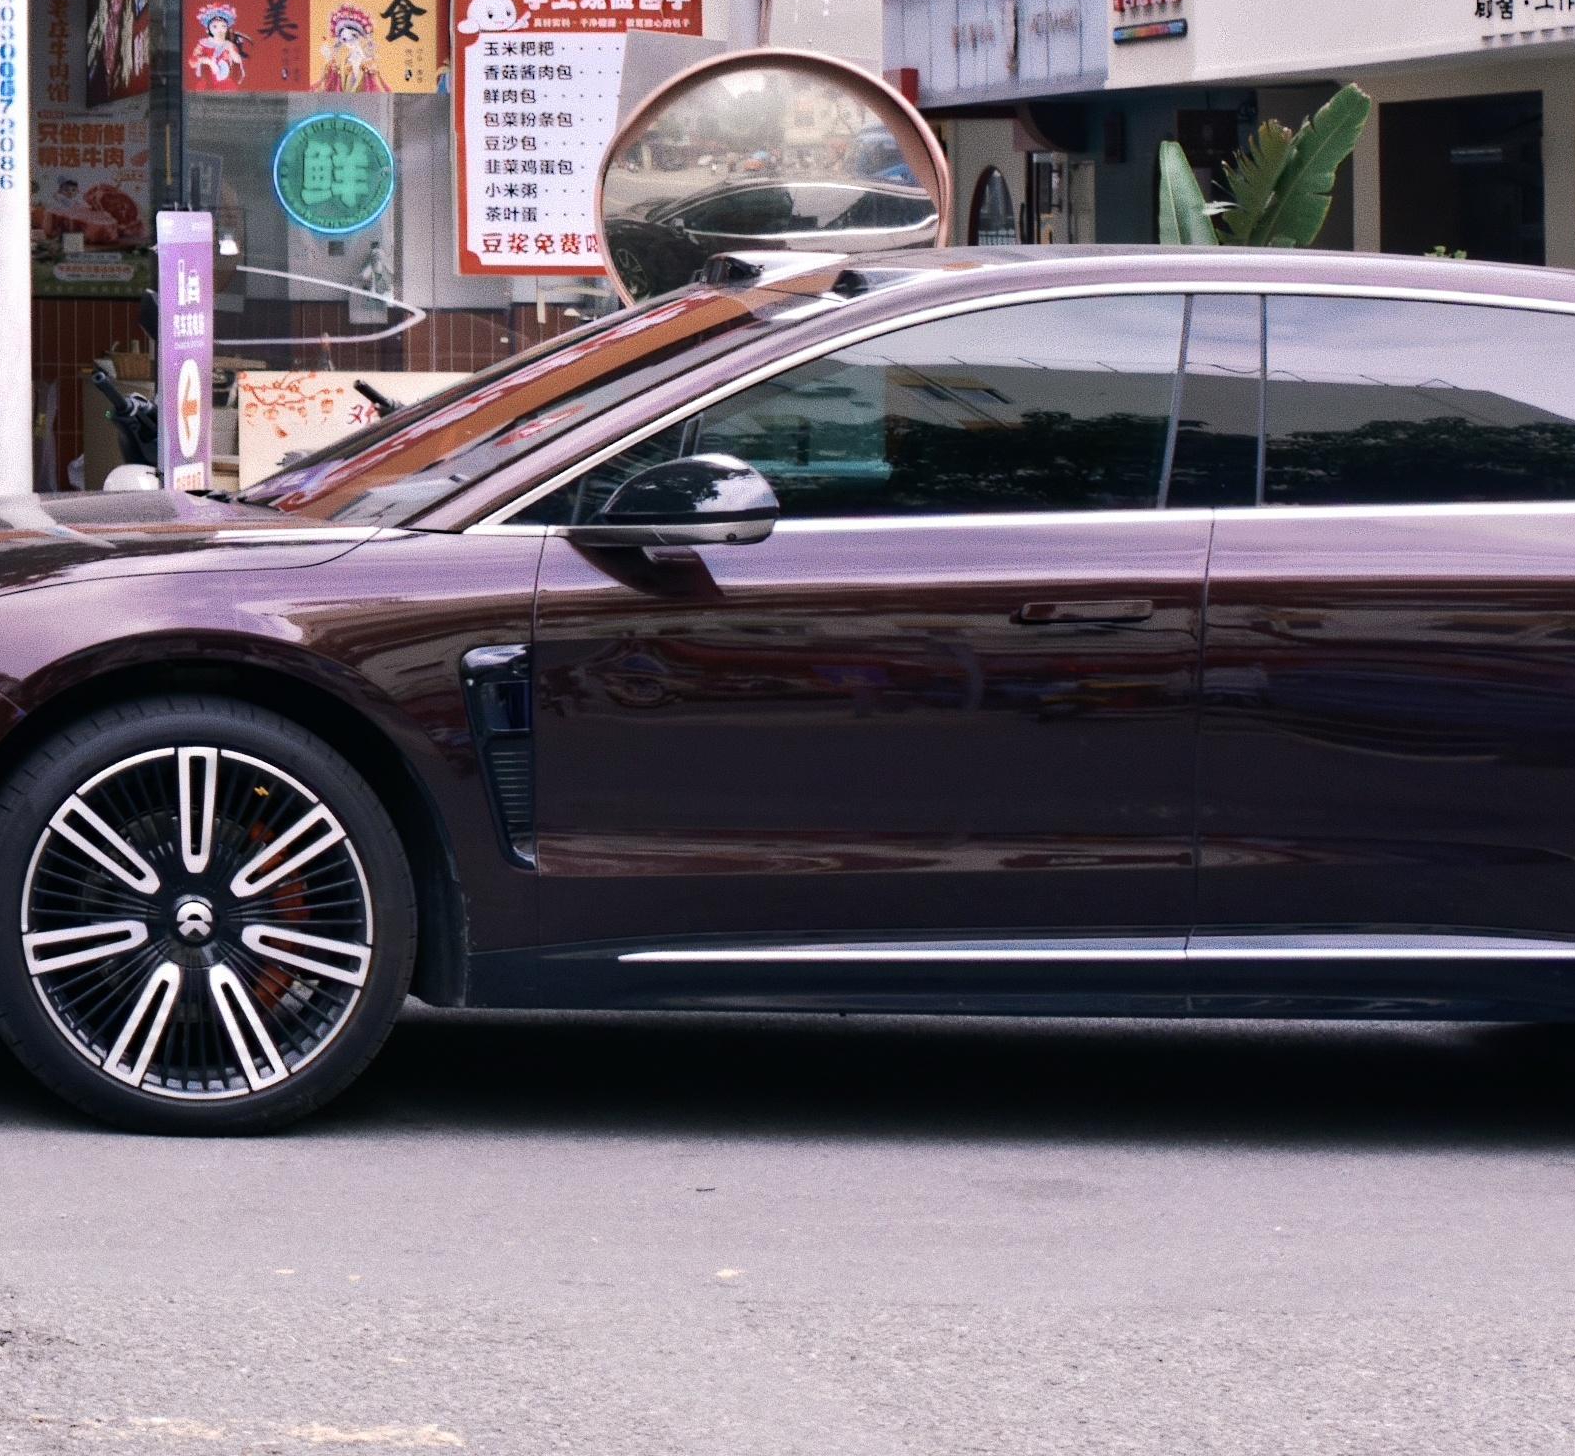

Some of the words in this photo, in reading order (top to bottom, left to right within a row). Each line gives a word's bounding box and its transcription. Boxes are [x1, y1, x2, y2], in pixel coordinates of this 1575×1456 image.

[484, 41, 555, 57] 玉米粑粑
[484, 64, 573, 81] 香菇酱肉包
[484, 88, 537, 104] 鲜肉包
[484, 112, 573, 128] 包菜粉条包
[484, 136, 537, 152] 豆沙包
[301, 141, 370, 207] 鲜
[484, 159, 574, 175] 韭菜鸡蛋包
[485, 183, 537, 199] 小米粥
[485, 206, 538, 222] 茶叶蛋
